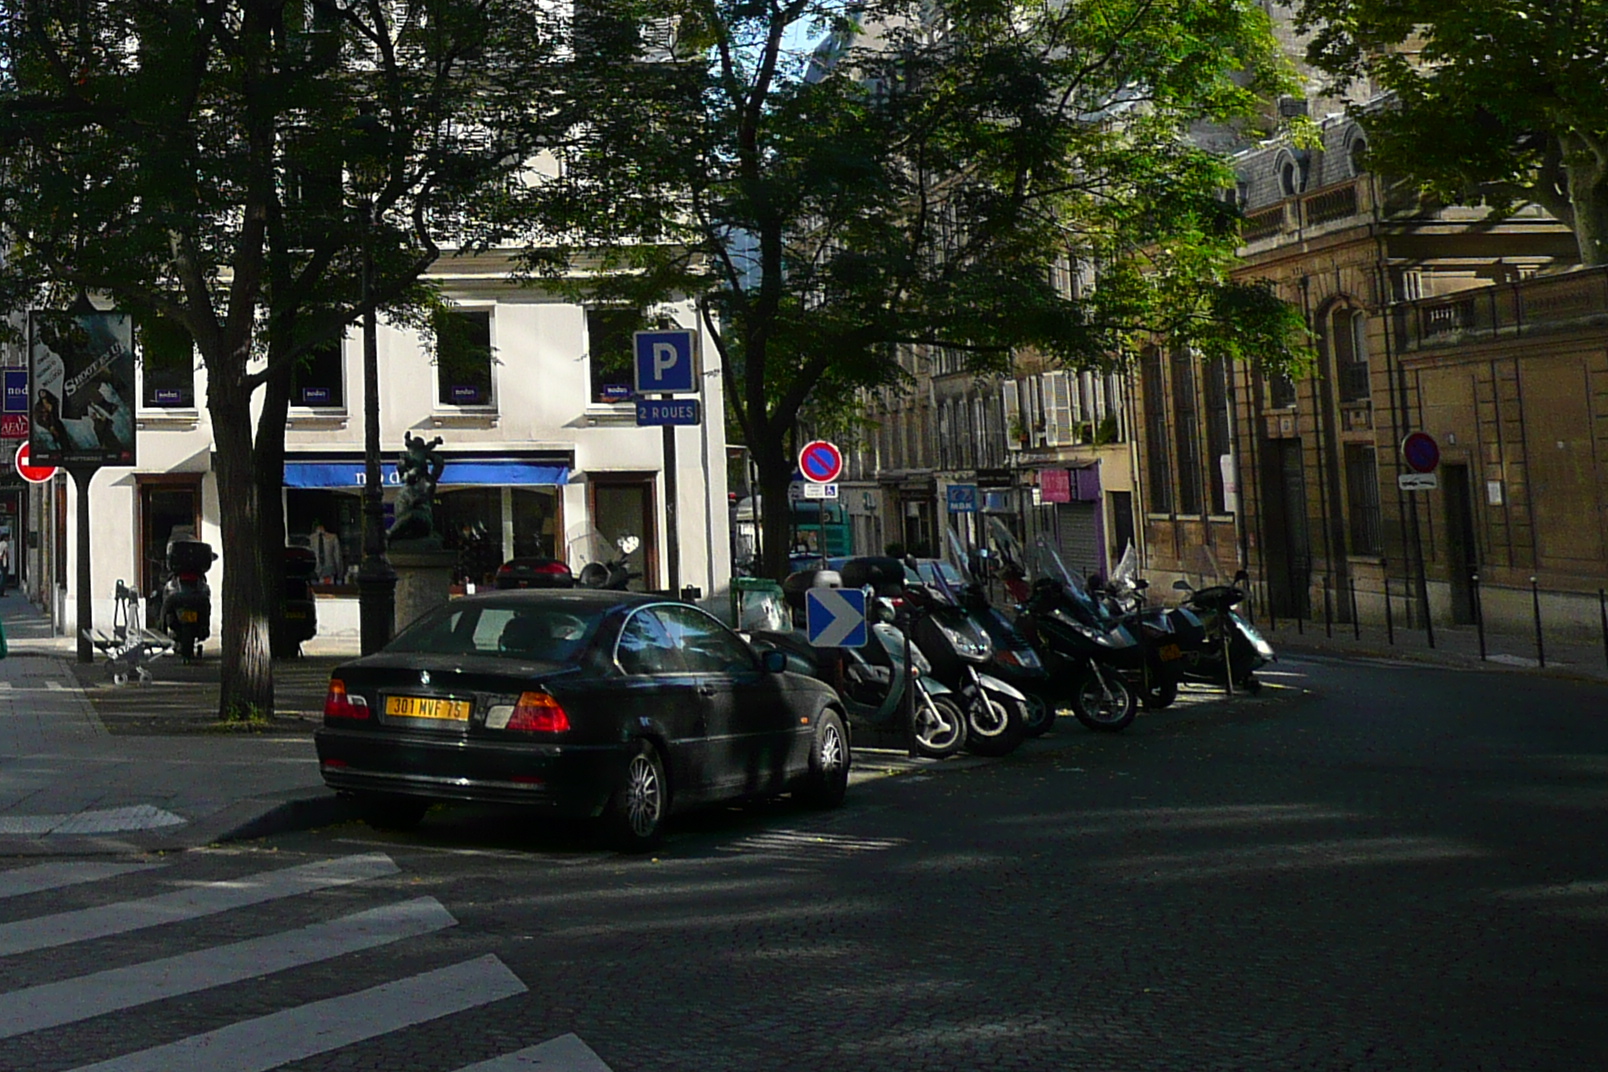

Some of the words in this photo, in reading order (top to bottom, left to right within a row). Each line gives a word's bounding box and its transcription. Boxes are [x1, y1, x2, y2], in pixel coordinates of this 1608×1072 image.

[653, 342, 678, 380] P
[639, 409, 647, 419] 2
[652, 407, 694, 419] ROUES
[393, 698, 415, 715] 301
[419, 700, 442, 717] MVF
[447, 702, 462, 719] 75
